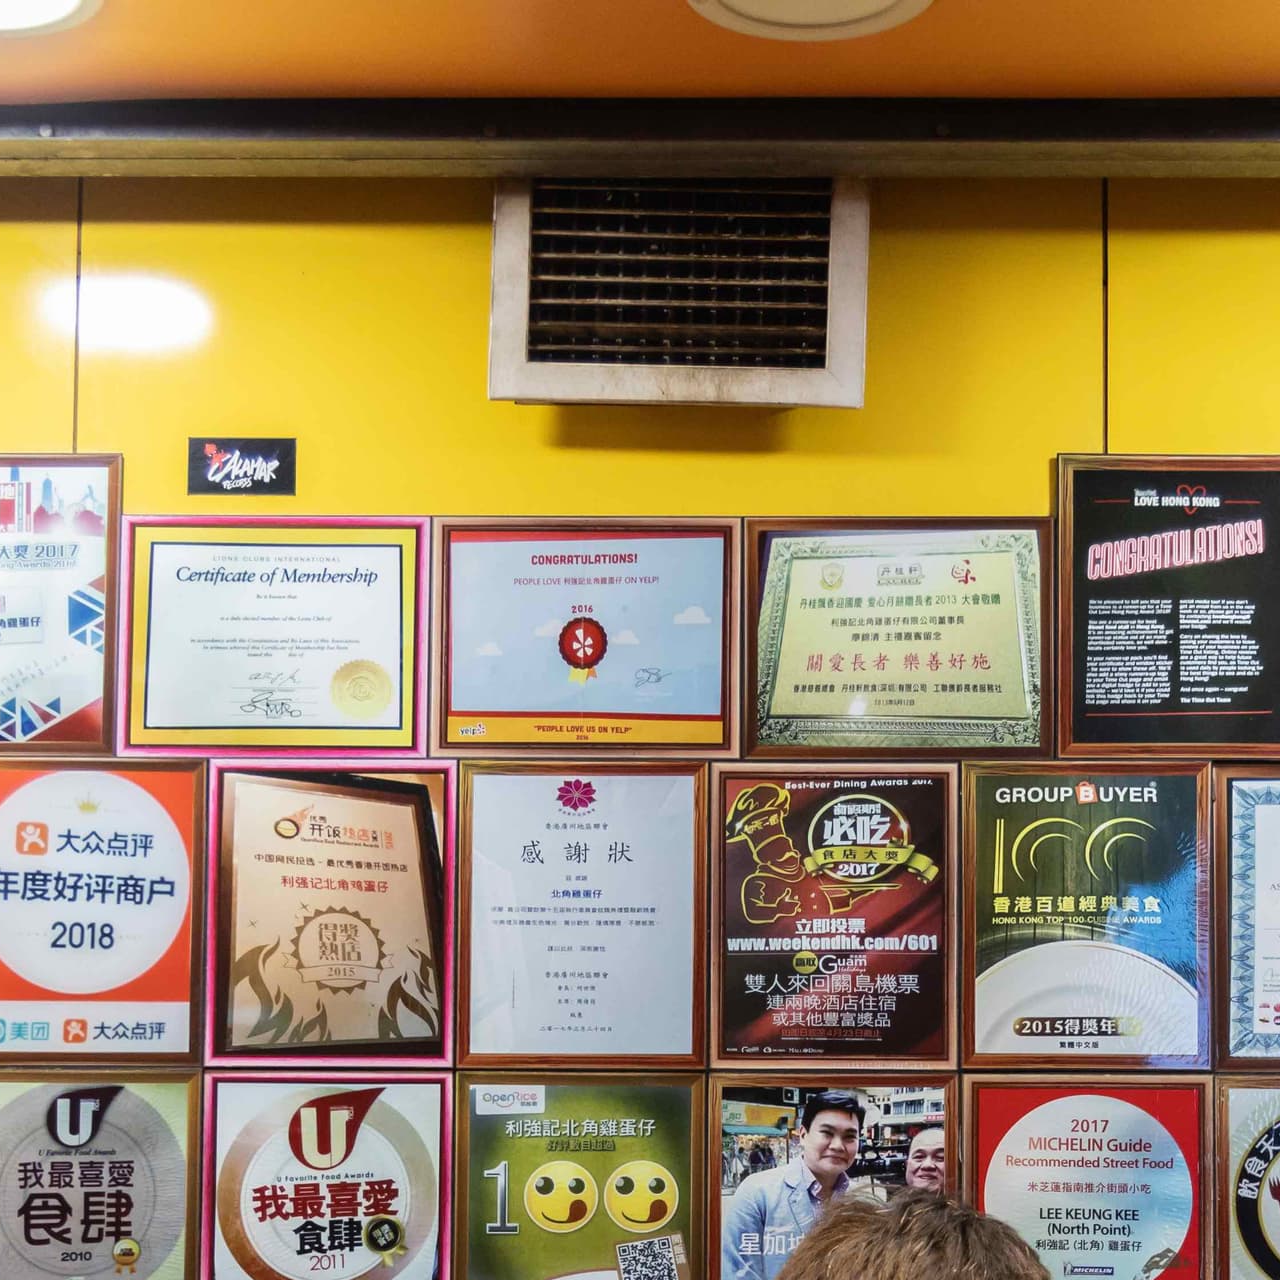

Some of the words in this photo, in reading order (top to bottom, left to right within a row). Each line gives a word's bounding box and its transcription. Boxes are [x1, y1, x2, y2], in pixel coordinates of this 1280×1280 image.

[1134, 497, 1159, 507] LOVE
[1161, 497, 1191, 507] HONG
[1192, 497, 1220, 507] KONG
[35, 544, 79, 560] 2017
[1087, 519, 1265, 580] CONGRATULATIONS!
[531, 554, 638, 566] CONGRATULATIONS!
[176, 566, 255, 583] Certificate
[260, 567, 276, 586] of
[281, 567, 378, 587] Membership
[513, 578, 541, 586] PEOPLE
[542, 578, 561, 586] LOVE
[624, 577, 638, 585] ON
[639, 576, 660, 585] YELP!
[571, 605, 593, 614] 2016
[806, 653, 891, 672] 關愛長者
[903, 652, 992, 672] 樂善好施
[785, 779, 831, 790] Best-Ever
[834, 779, 867, 789] Dining
[870, 778, 909, 787] Awards
[995, 786, 1073, 803] GROUP
[822, 815, 891, 846] 必吃
[56, 829, 154, 858] 大众点评
[520, 840, 634, 864] 感謝狀
[836, 863, 880, 877] 2017
[280, 875, 389, 894] 利强记北角鸡蛋仔
[993, 895, 1161, 913] 香港百道經典美食
[795, 918, 866, 935] 立即投票
[992, 916, 1017, 925] HONG
[1019, 916, 1044, 924] KONG
[1046, 915, 1064, 924] TOP
[1068, 915, 1085, 924] 100
[1122, 915, 1162, 924] AWARDS
[50, 922, 115, 949] 2018
[727, 935, 938, 951] www.weekendhk.com/601
[327, 966, 356, 977] 2015
[744, 973, 920, 994] 雙人來回關島機票
[766, 994, 897, 1012] 連兩晚酒店住宿
[772, 1012, 891, 1028] 或其他豐富獎品
[10, 1022, 50, 1040] 美团
[93, 1022, 166, 1041] 大众点评
[505, 1118, 656, 1138] 利強記北角雞蛋仔
[1070, 1119, 1109, 1133] 2017
[1028, 1137, 1103, 1152] MICHELIN
[1106, 1138, 1152, 1153] Guide
[1006, 1155, 1100, 1168] Recommended
[1103, 1157, 1139, 1169] Street
[1142, 1157, 1174, 1169] Food
[17, 1160, 135, 1189] 我最喜愛
[1027, 1181, 1152, 1195] 米芝蓮指南推介街頭小吃
[252, 1179, 399, 1223] 我最喜愛
[17, 1190, 135, 1246] 食肆
[1039, 1207, 1062, 1219] LEE
[1065, 1208, 1112, 1220] KEUNG
[1115, 1209, 1139, 1221] KEE
[292, 1218, 363, 1256] 食肆
[1047, 1223, 1090, 1236] (North
[1092, 1224, 1131, 1236] Point)
[1035, 1239, 1070, 1250] 利強記
[1073, 1240, 1105, 1251] (北角)
[1108, 1240, 1142, 1251] 雞蛋仔
[60, 1251, 92, 1262] 2010
[309, 1254, 345, 1271] 2011
